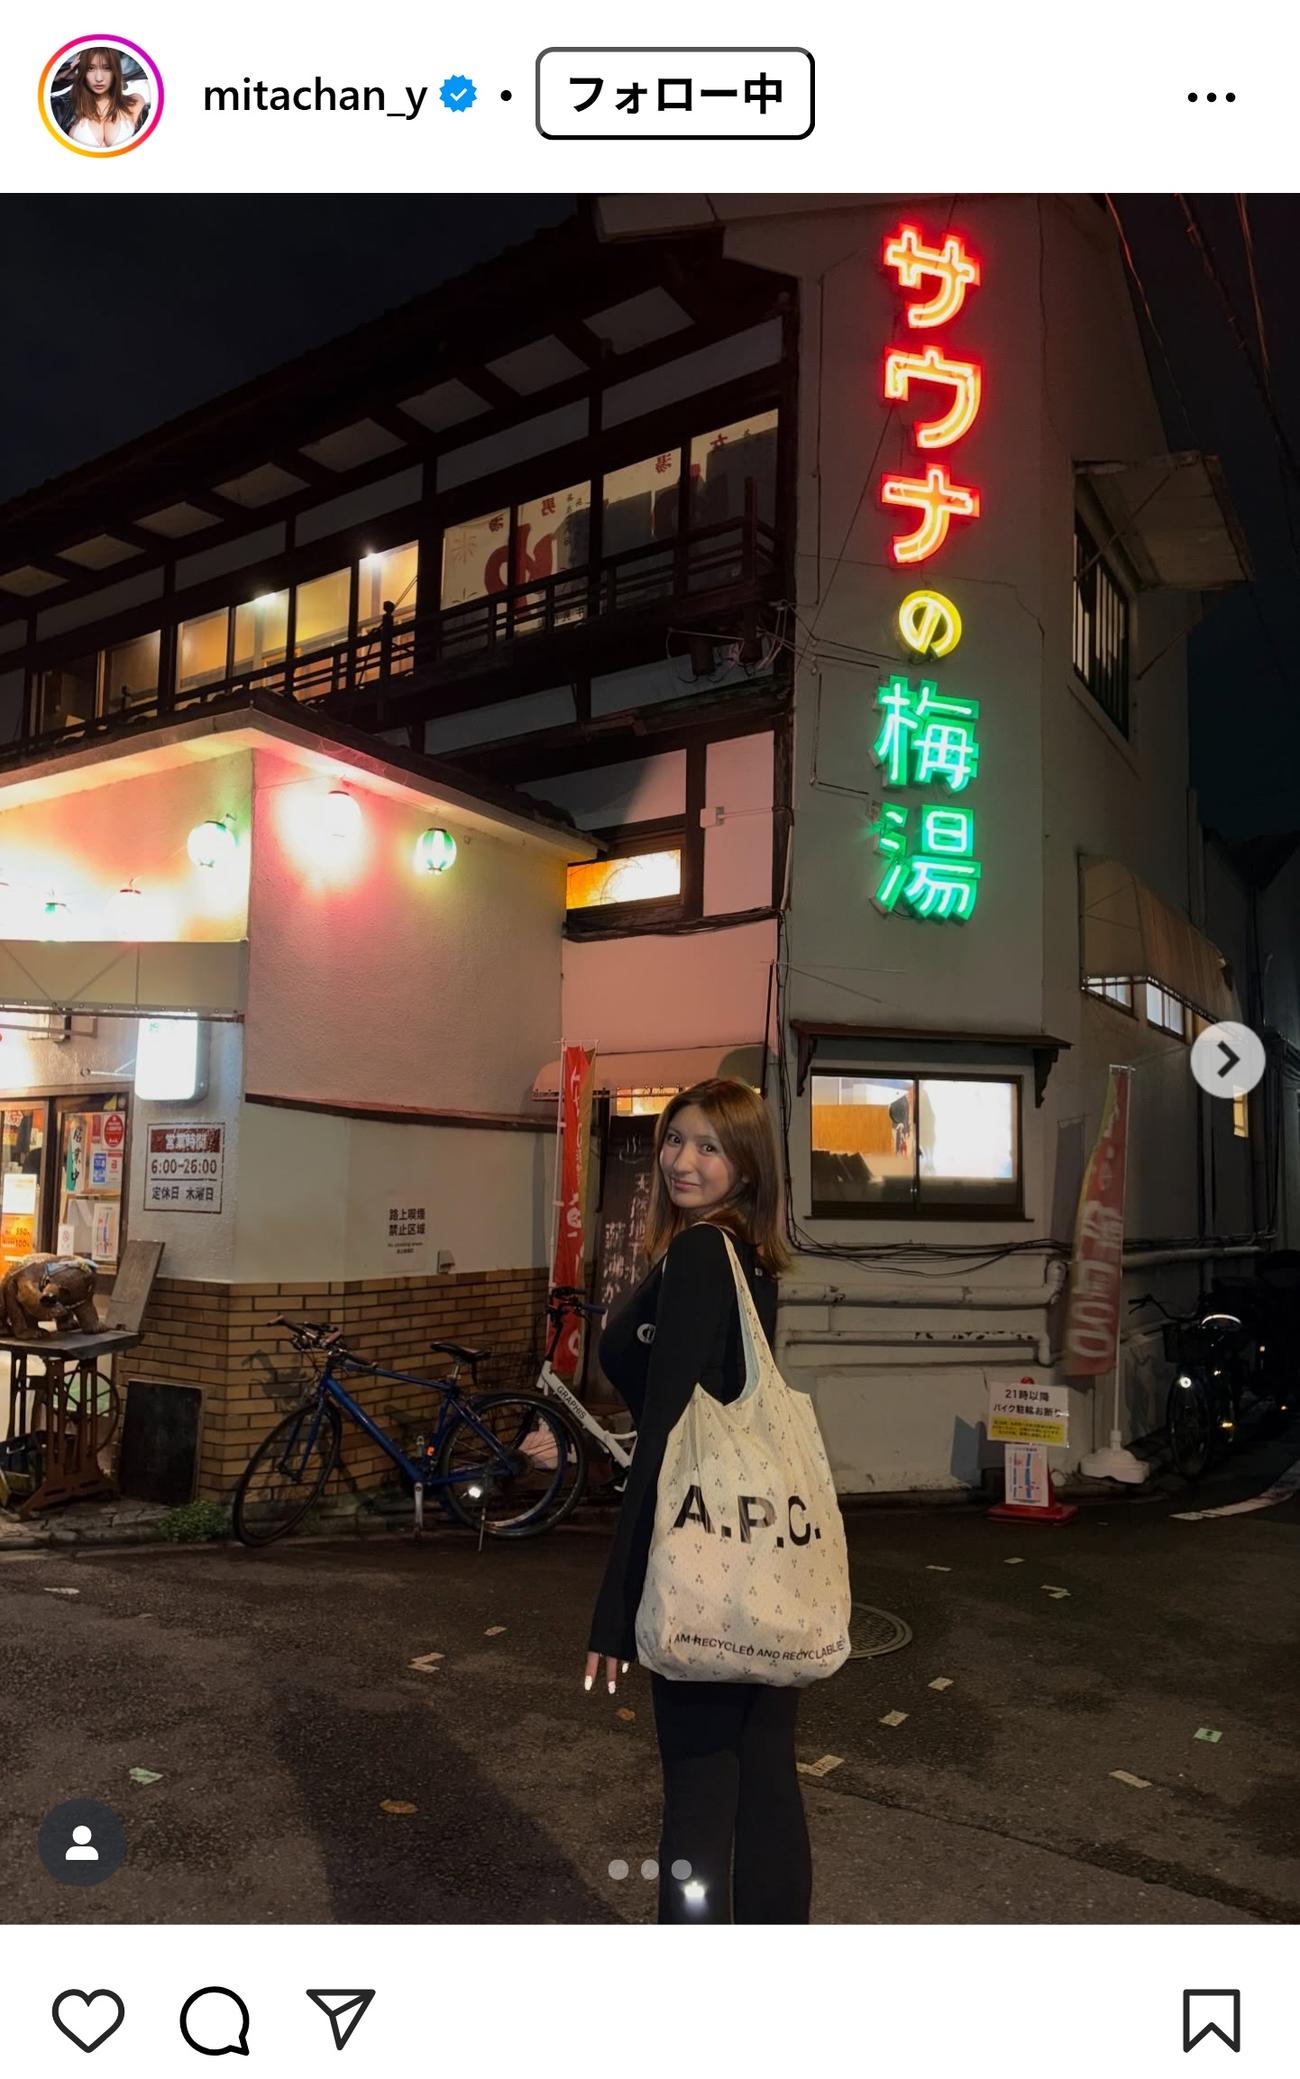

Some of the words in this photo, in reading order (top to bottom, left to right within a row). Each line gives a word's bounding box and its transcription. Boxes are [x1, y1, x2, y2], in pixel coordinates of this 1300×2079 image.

[871, 222, 981, 925] サウナの梅湯
[152, 1186, 180, 1201] 定休日
[185, 1186, 214, 1201] 木曜日
[389, 1223, 426, 1236] 禁止区域
[557, 1385, 588, 1419] GRAPHIS
[1005, 1388, 1050, 1402] 21時以降
[673, 1485, 822, 1548] A.P.C.
[674, 1634, 691, 1644] AM
[693, 1635, 755, 1657] RECYCLED
[756, 1648, 781, 1660] AND
[782, 1639, 845, 1661] RECYCLABLE
